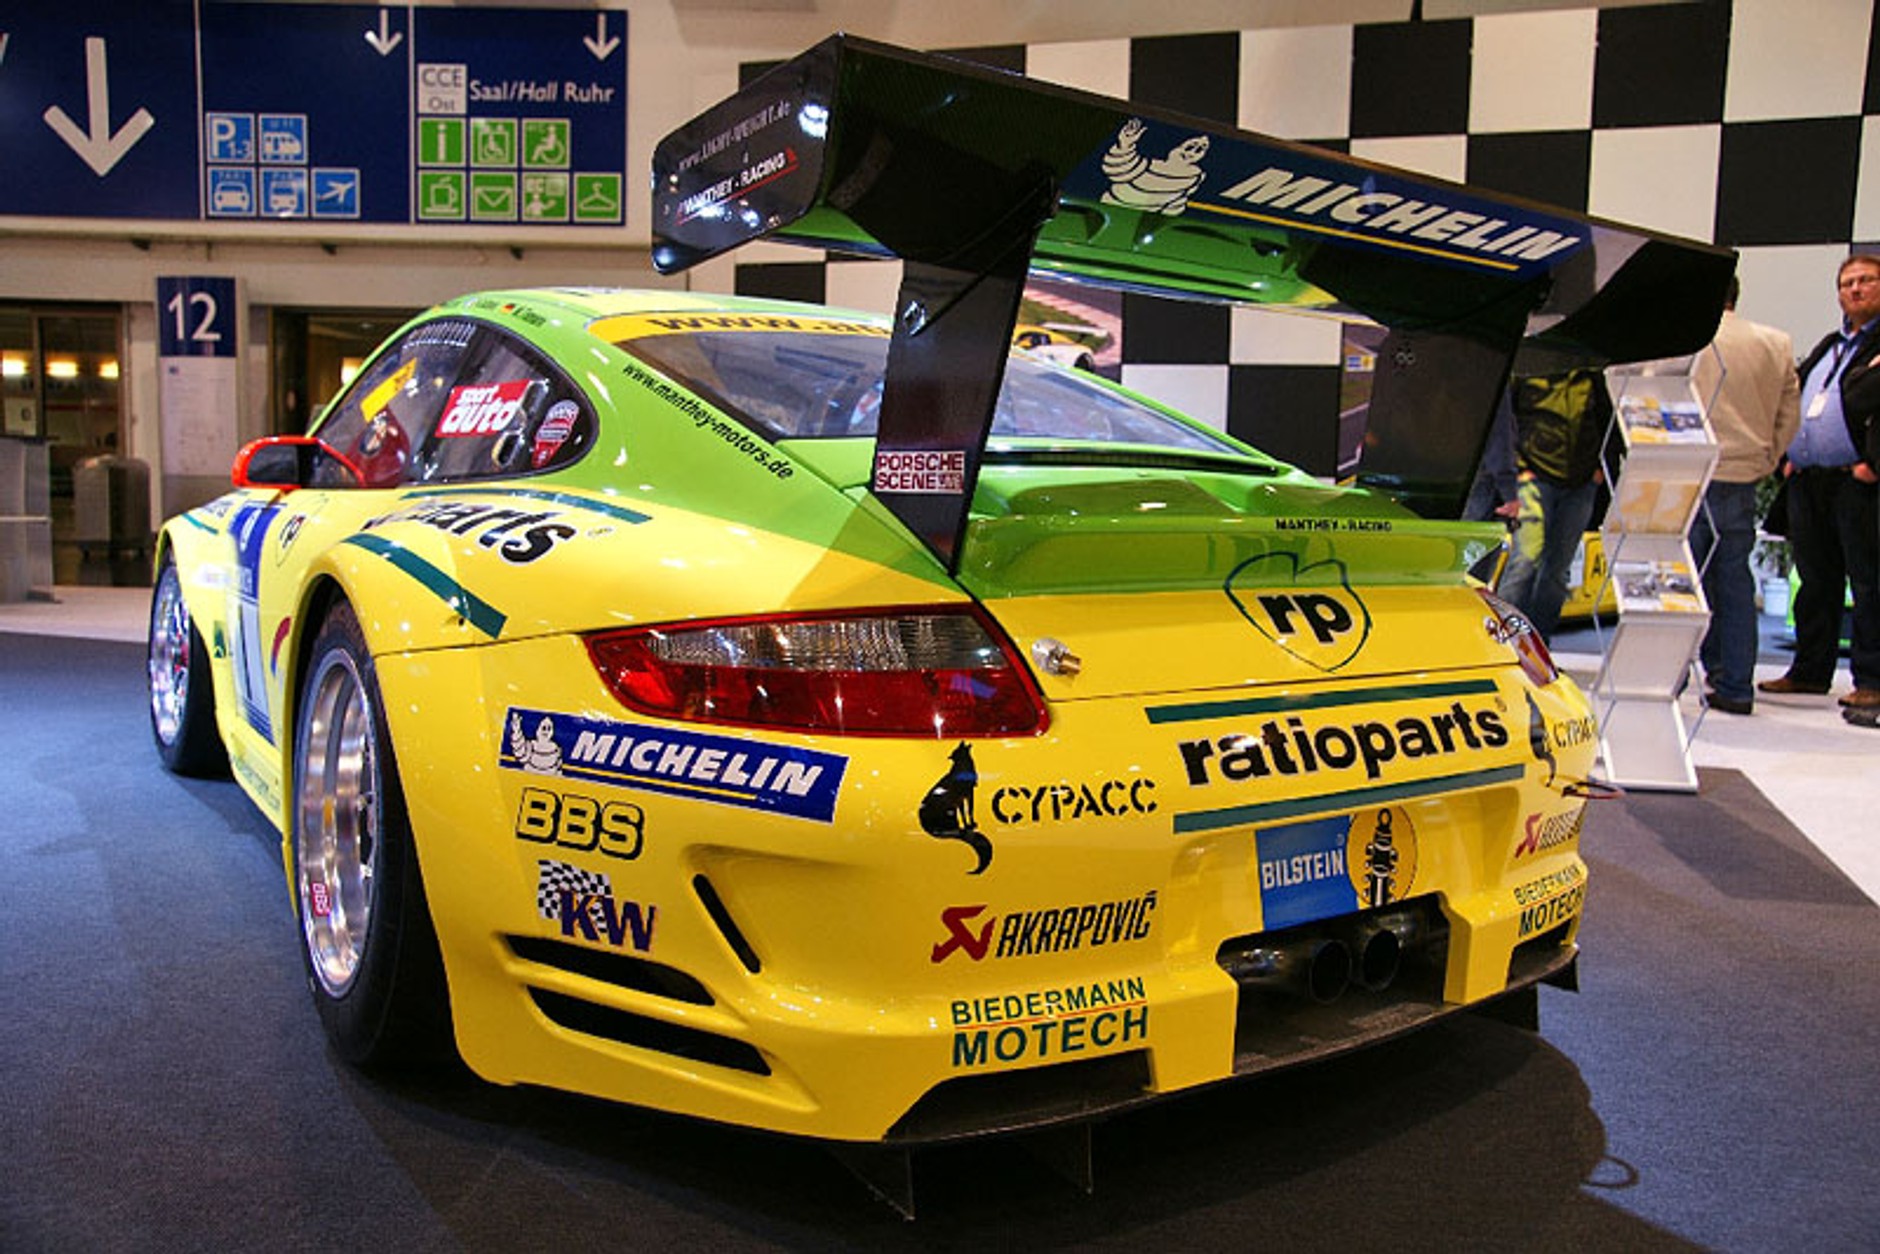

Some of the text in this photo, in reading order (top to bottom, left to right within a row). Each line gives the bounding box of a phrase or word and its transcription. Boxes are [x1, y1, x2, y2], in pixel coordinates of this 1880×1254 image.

[421, 68, 463, 88] CCE
[564, 81, 615, 103] Ruhr
[428, 97, 455, 111] Ost
[211, 118, 236, 157] P
[1218, 167, 1581, 261] MICHELIN
[168, 292, 222, 342] 12
[440, 398, 522, 433] auto
[622, 364, 795, 480] www.manthey-motors.de
[876, 472, 937, 490] SCENE
[877, 453, 963, 471] PORSCHE
[1275, 517, 1338, 531] MANTHEY
[1348, 519, 1393, 532] RACING
[1257, 593, 1353, 644] rp
[569, 730, 824, 797] MICHELIN
[1177, 701, 1510, 786] ratioparts
[515, 786, 645, 861] BBS
[991, 778, 1158, 824] CYPACC
[1261, 849, 1345, 890] BILSTEIN
[559, 888, 658, 952] KW
[951, 976, 1147, 1027] BIEDERMANN
[952, 1005, 1149, 1068] MOTECH
